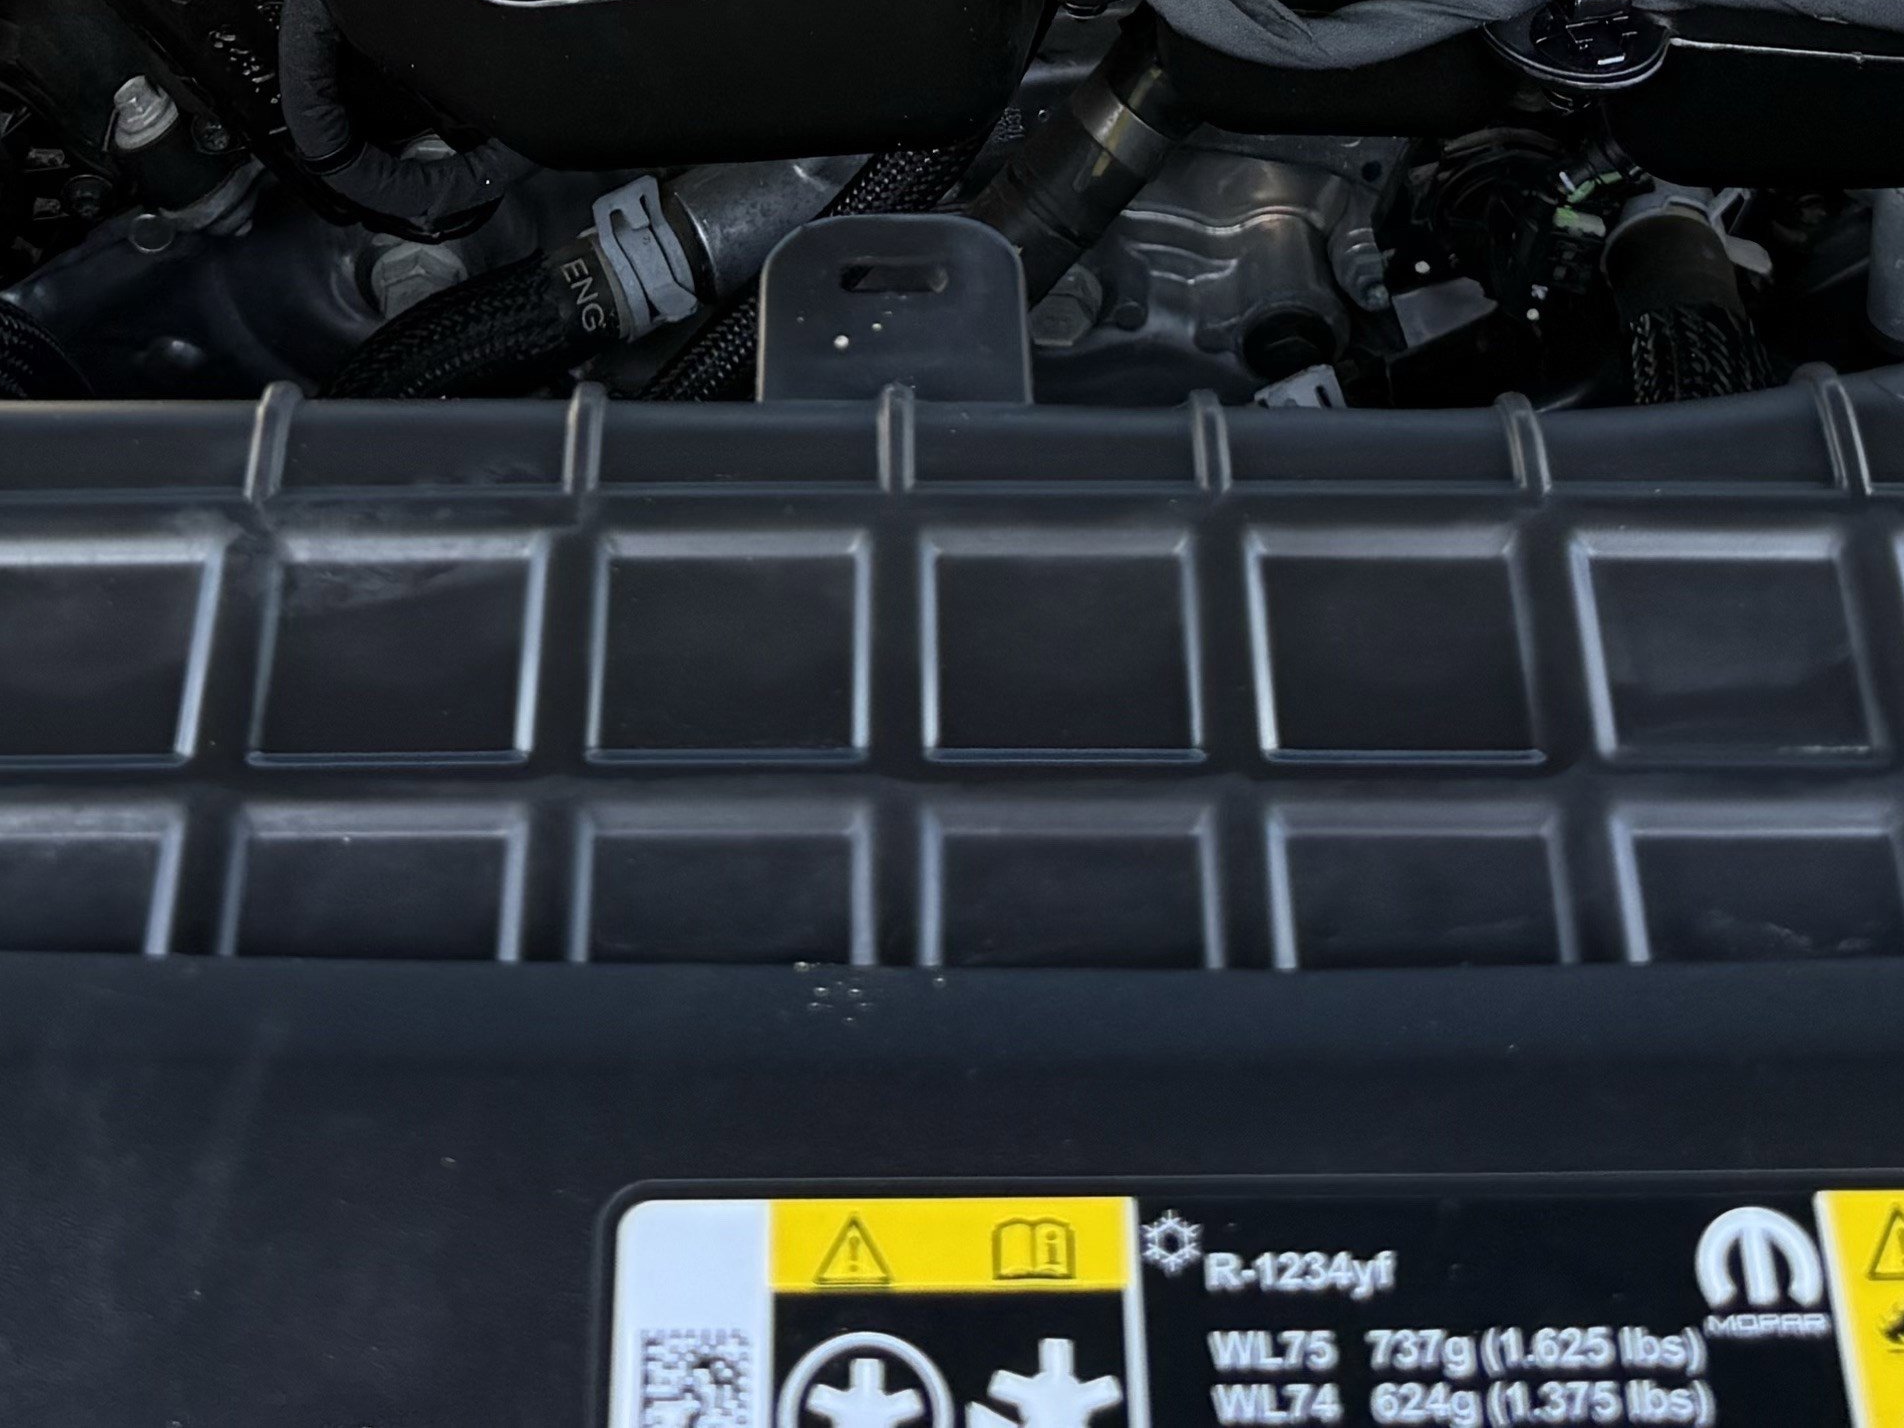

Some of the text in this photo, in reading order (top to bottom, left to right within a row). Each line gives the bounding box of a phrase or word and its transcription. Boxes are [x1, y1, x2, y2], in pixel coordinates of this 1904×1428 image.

[559, 257, 606, 333] ENG
[1204, 1249, 1394, 1300] R-1234yf
[1702, 1312, 1832, 1339] MOPAR
[1207, 1324, 1708, 1380] WL75 737g (1.625 lbs)
[1211, 1379, 1718, 1428] WL74 624g (1.375 lbs)
